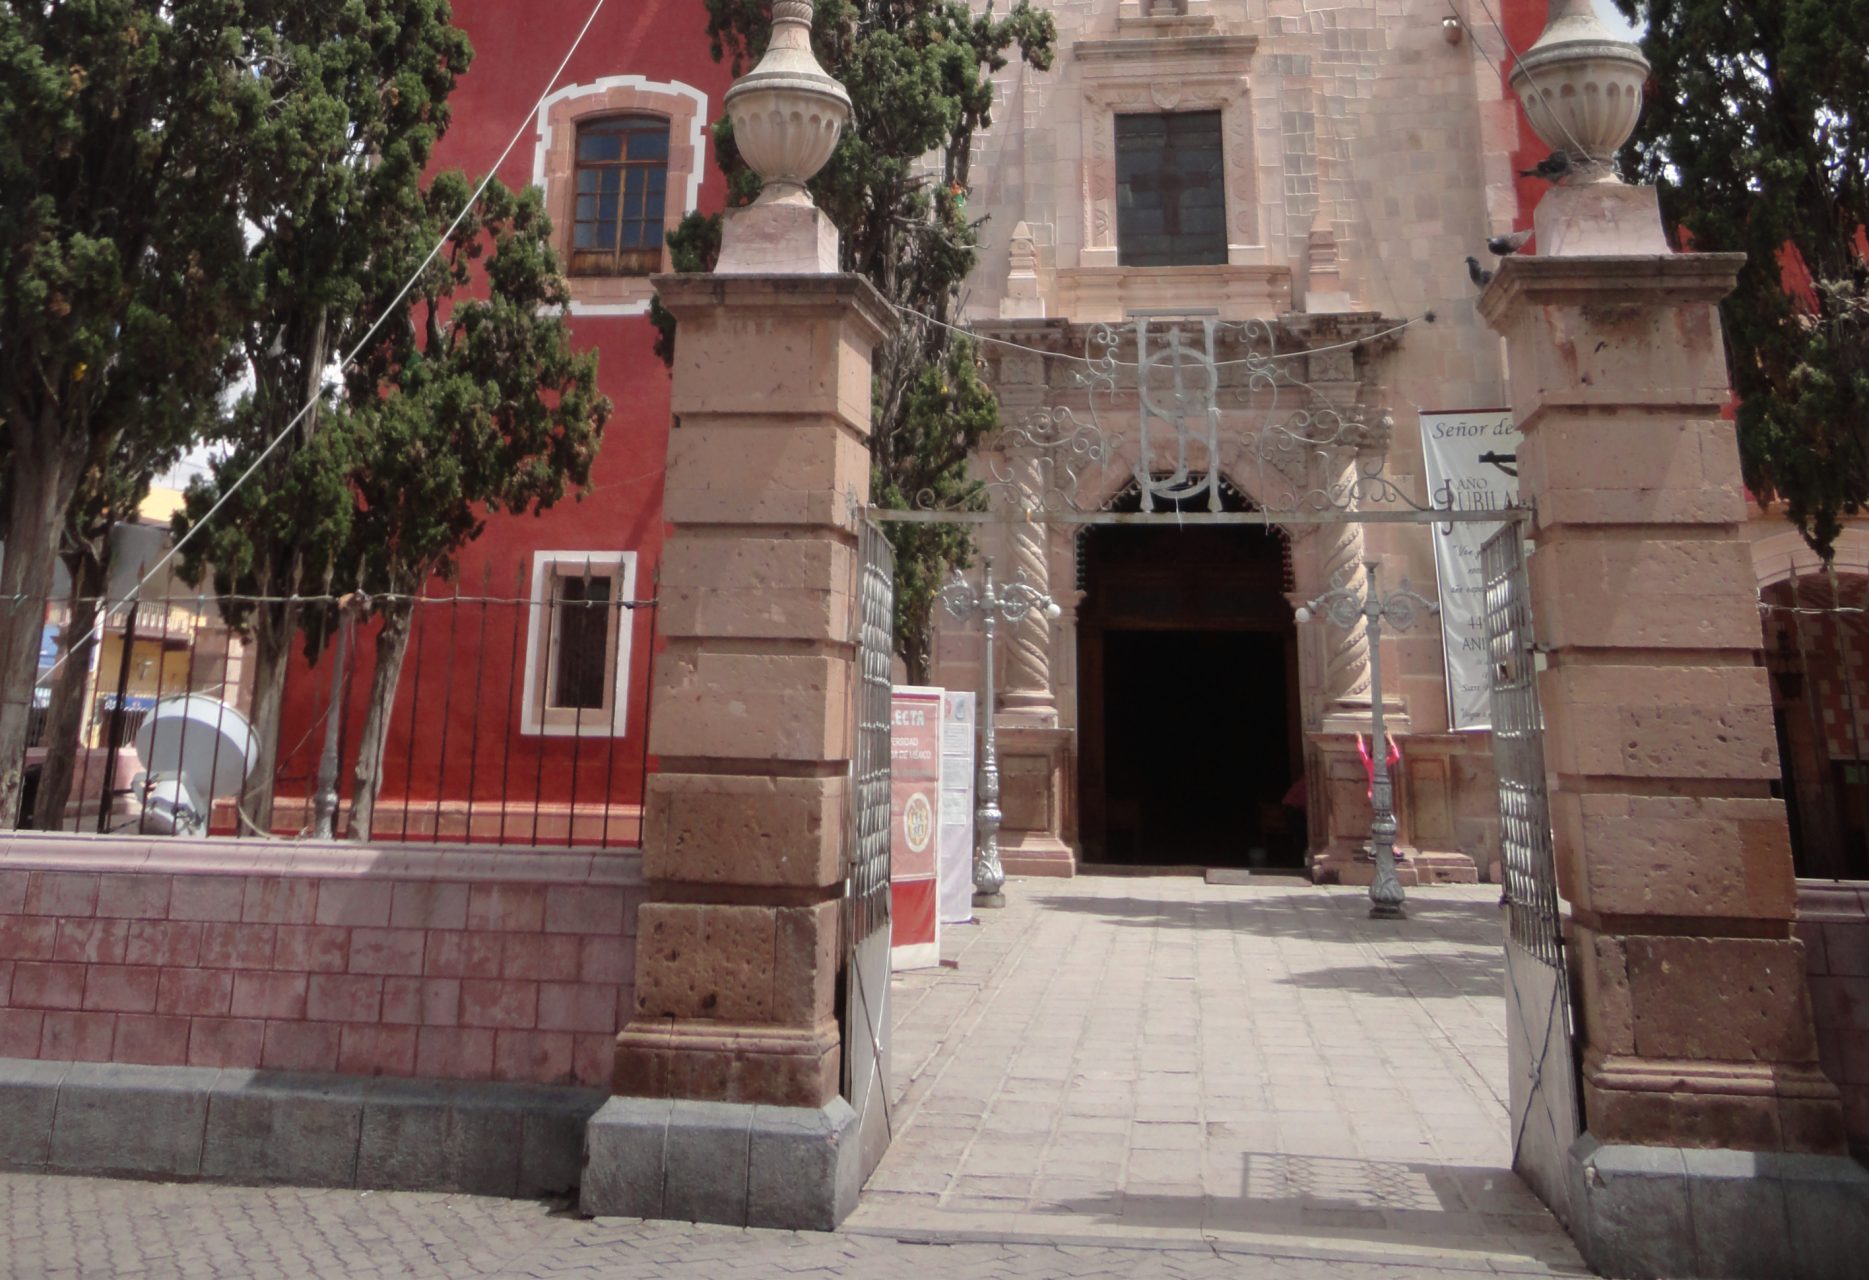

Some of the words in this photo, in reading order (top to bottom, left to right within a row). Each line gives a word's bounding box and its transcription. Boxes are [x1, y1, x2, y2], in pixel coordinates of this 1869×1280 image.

[1432, 422, 1488, 439] Señor
[1493, 418, 1514, 436] de
[1457, 477, 1488, 490] AÑO
[891, 710, 924, 725] ECTA
